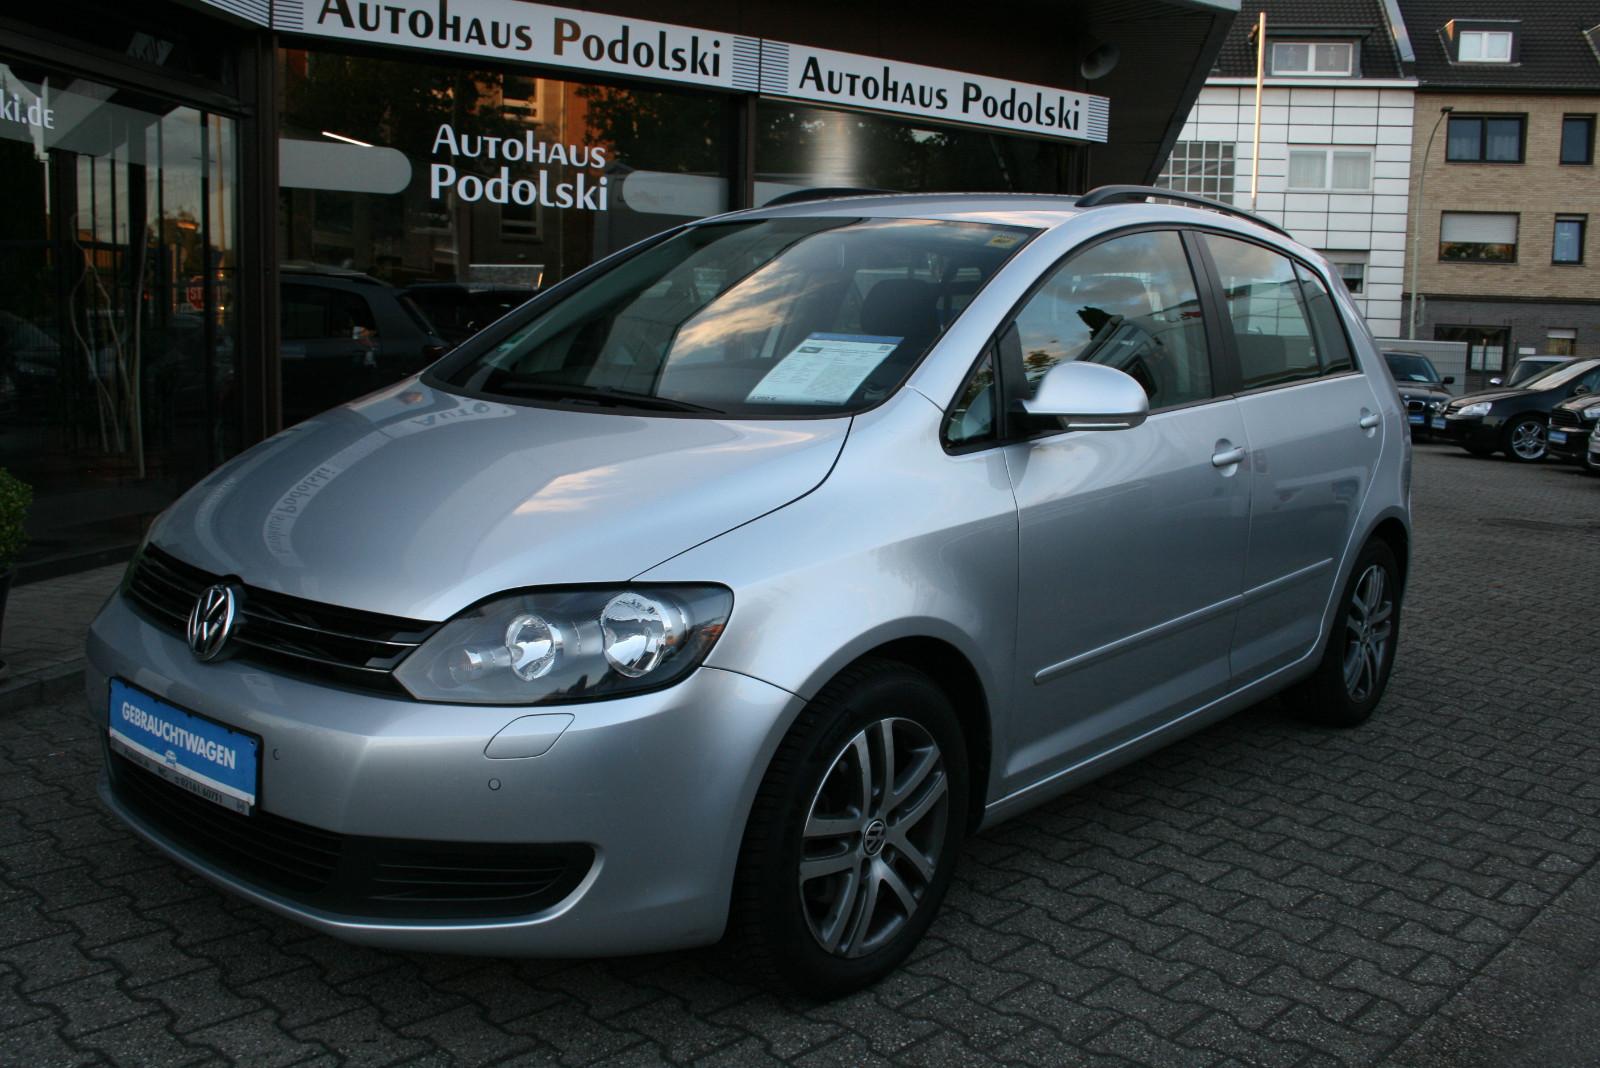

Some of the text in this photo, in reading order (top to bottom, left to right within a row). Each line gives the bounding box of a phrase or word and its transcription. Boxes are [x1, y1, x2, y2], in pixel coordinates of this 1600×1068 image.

[553, 17, 720, 77] Podolski
[962, 81, 1080, 131] Podolski
[430, 163, 608, 211] Podolski
[121, 701, 236, 770] GEBRAUCHTWAGEN
